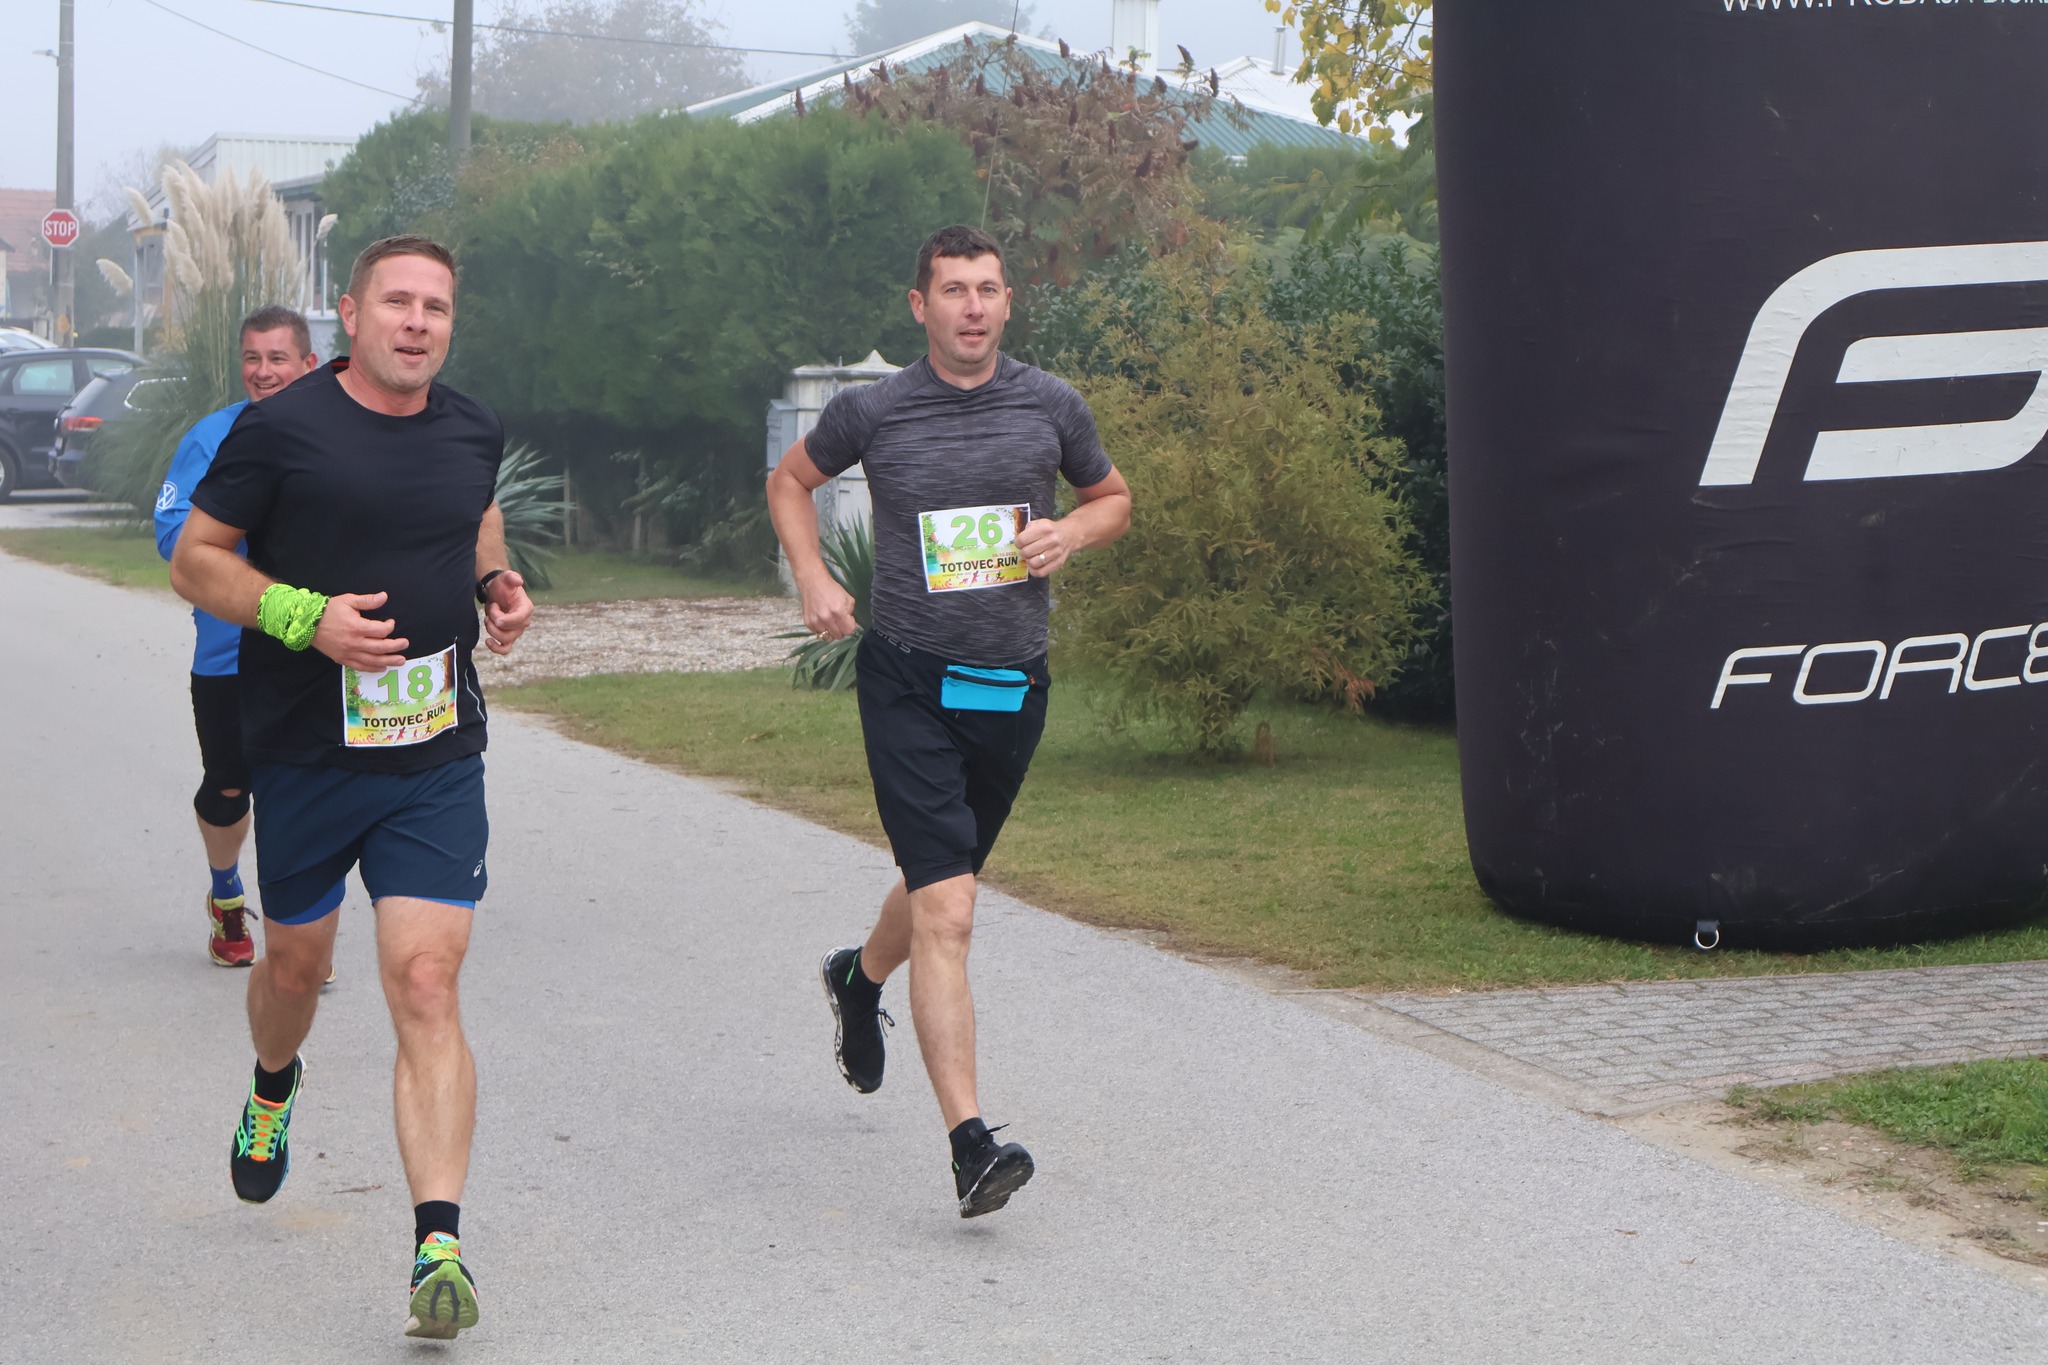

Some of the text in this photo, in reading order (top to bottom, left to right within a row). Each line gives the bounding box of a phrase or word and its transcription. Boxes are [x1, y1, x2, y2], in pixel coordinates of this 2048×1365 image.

[45, 220, 75, 236] STOP
[951, 513, 1003, 548] 26
[940, 559, 994, 573] TOTOVEC
[998, 556, 1018, 567] RUN
[378, 665, 433, 702] 18
[362, 714, 423, 727] TOTOVEC
[427, 703, 446, 721] RUN
